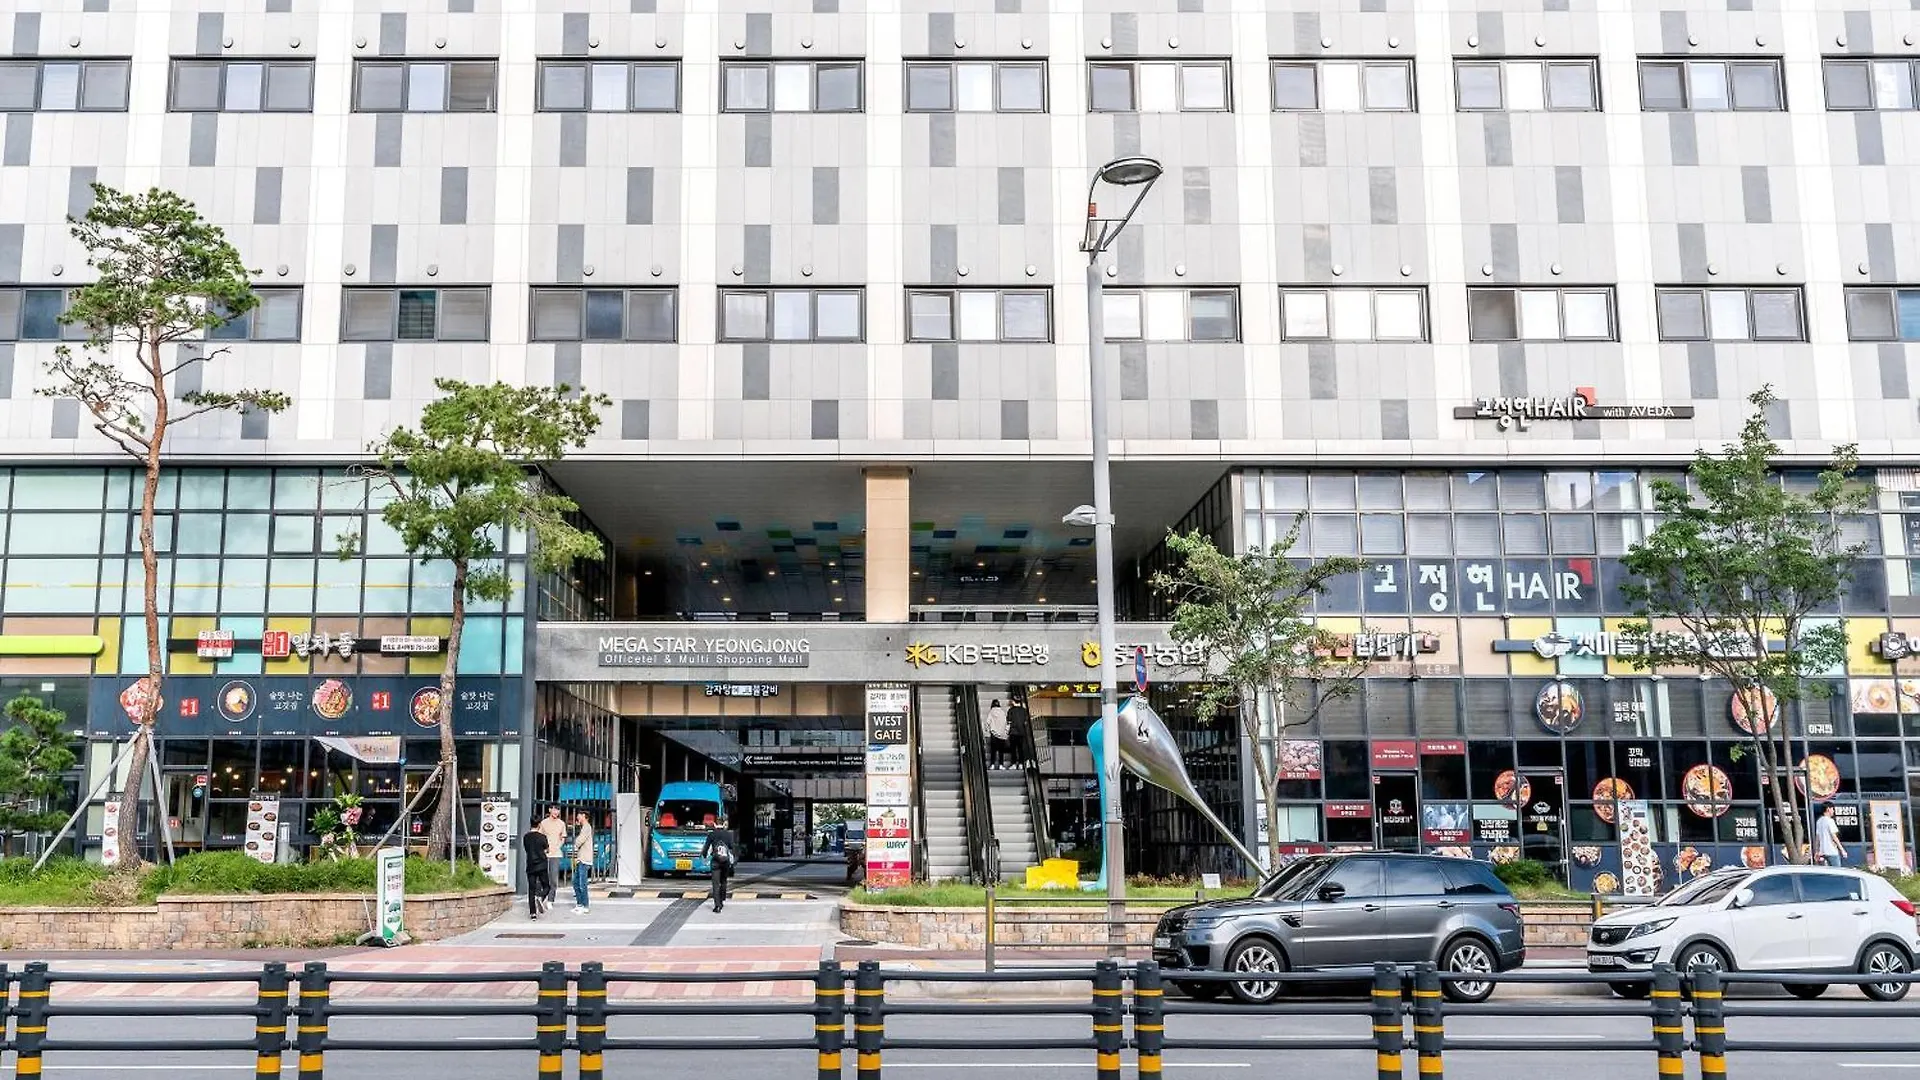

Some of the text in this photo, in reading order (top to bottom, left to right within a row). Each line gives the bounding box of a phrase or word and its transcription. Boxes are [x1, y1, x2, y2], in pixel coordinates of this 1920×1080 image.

[1603, 406, 1625, 417] with
[1629, 405, 1675, 417] AVEDA
[599, 636, 810, 653] MEGA STAR YEONGJONG
[605, 654, 803, 665] Officetel & Multi Shopping Mall
[945, 643, 1049, 665] KB국민은행
[705, 684, 731, 696] 감자탕
[753, 684, 778, 696] 불갈비
[873, 716, 903, 726] WEST
[874, 729, 902, 740] GATE
